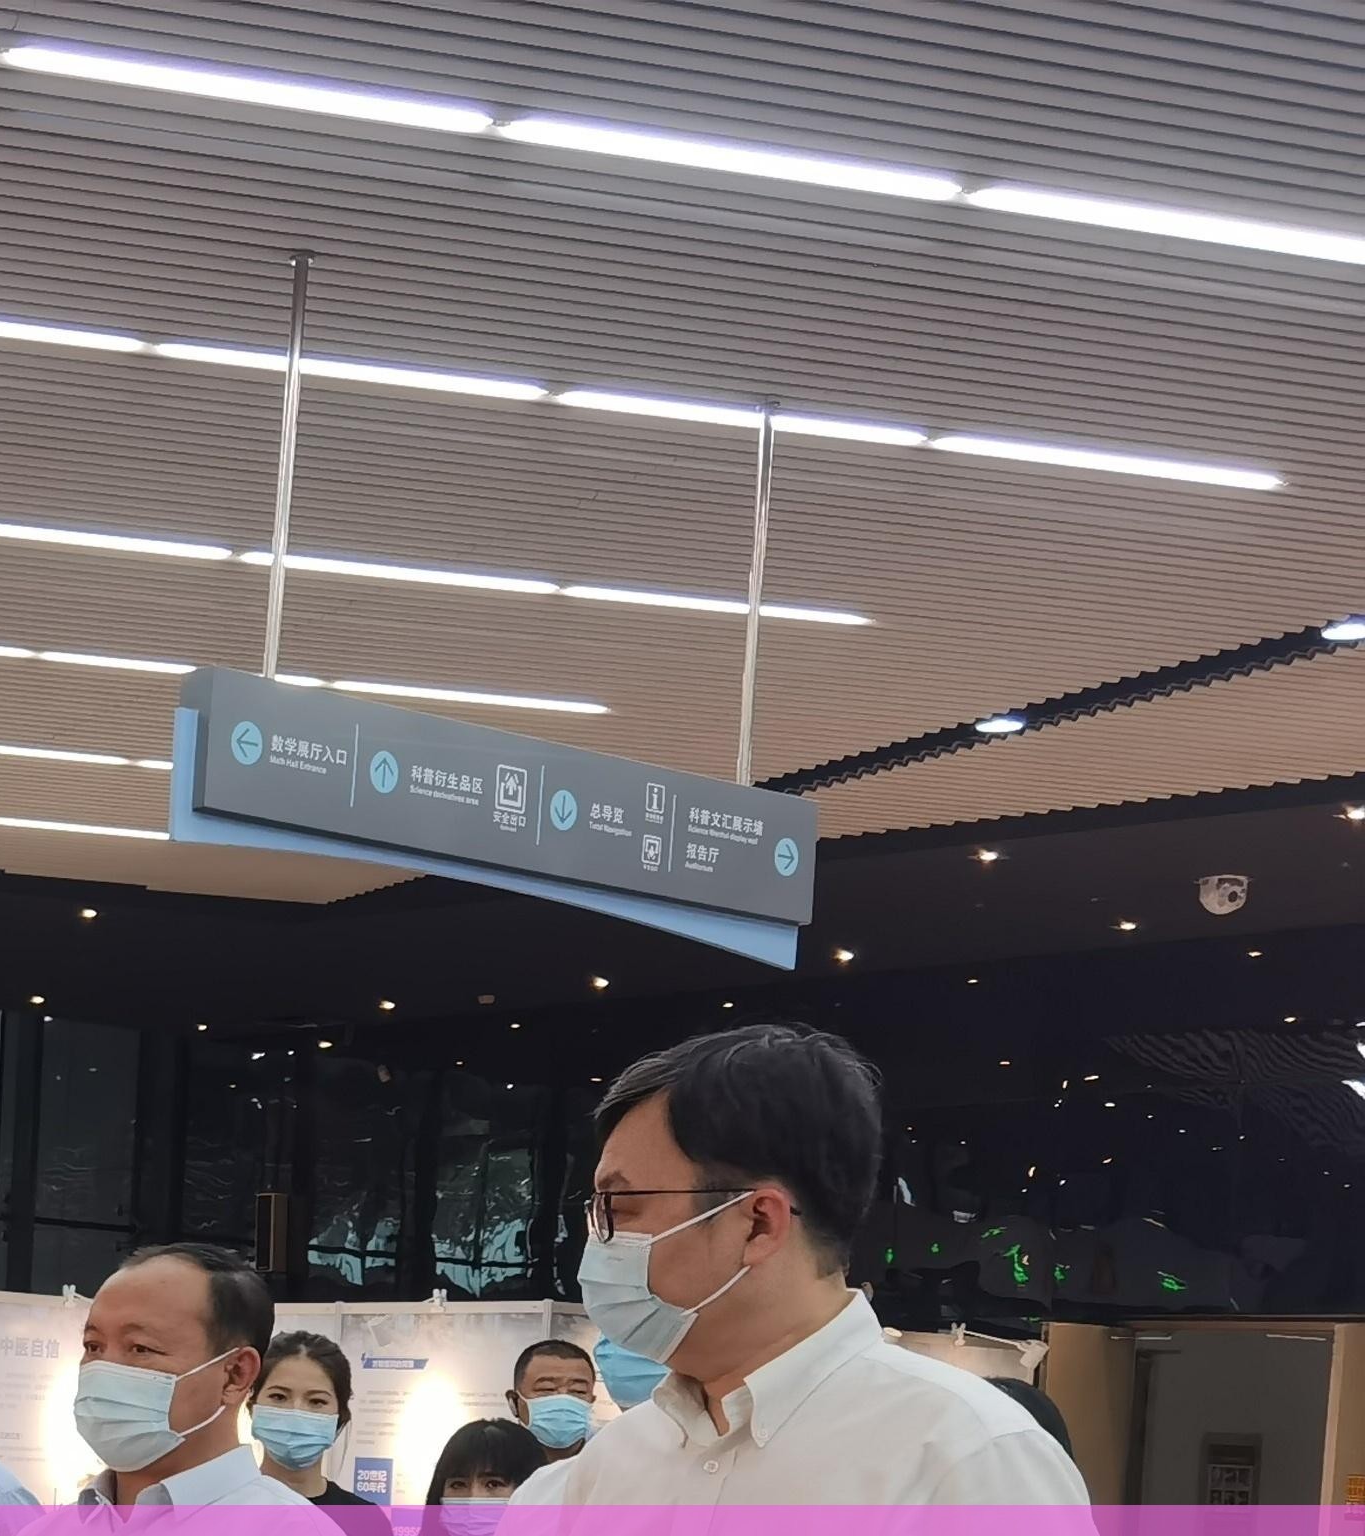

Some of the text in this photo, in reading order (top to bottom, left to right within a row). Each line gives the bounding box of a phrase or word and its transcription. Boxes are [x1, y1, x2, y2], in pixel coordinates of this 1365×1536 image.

[270, 734, 348, 766] 数学展厅入口
[411, 765, 484, 794] 科普衍生品区
[493, 811, 526, 828] 安全出口
[590, 803, 625, 824] 总导览
[689, 807, 764, 836] 科普文汇展示墙
[686, 842, 720, 863] 报告厅
[0, 1336, 60, 1358] 中医自信
[357, 1470, 387, 1482] 20世纪
[357, 1481, 387, 1494] 60年代
